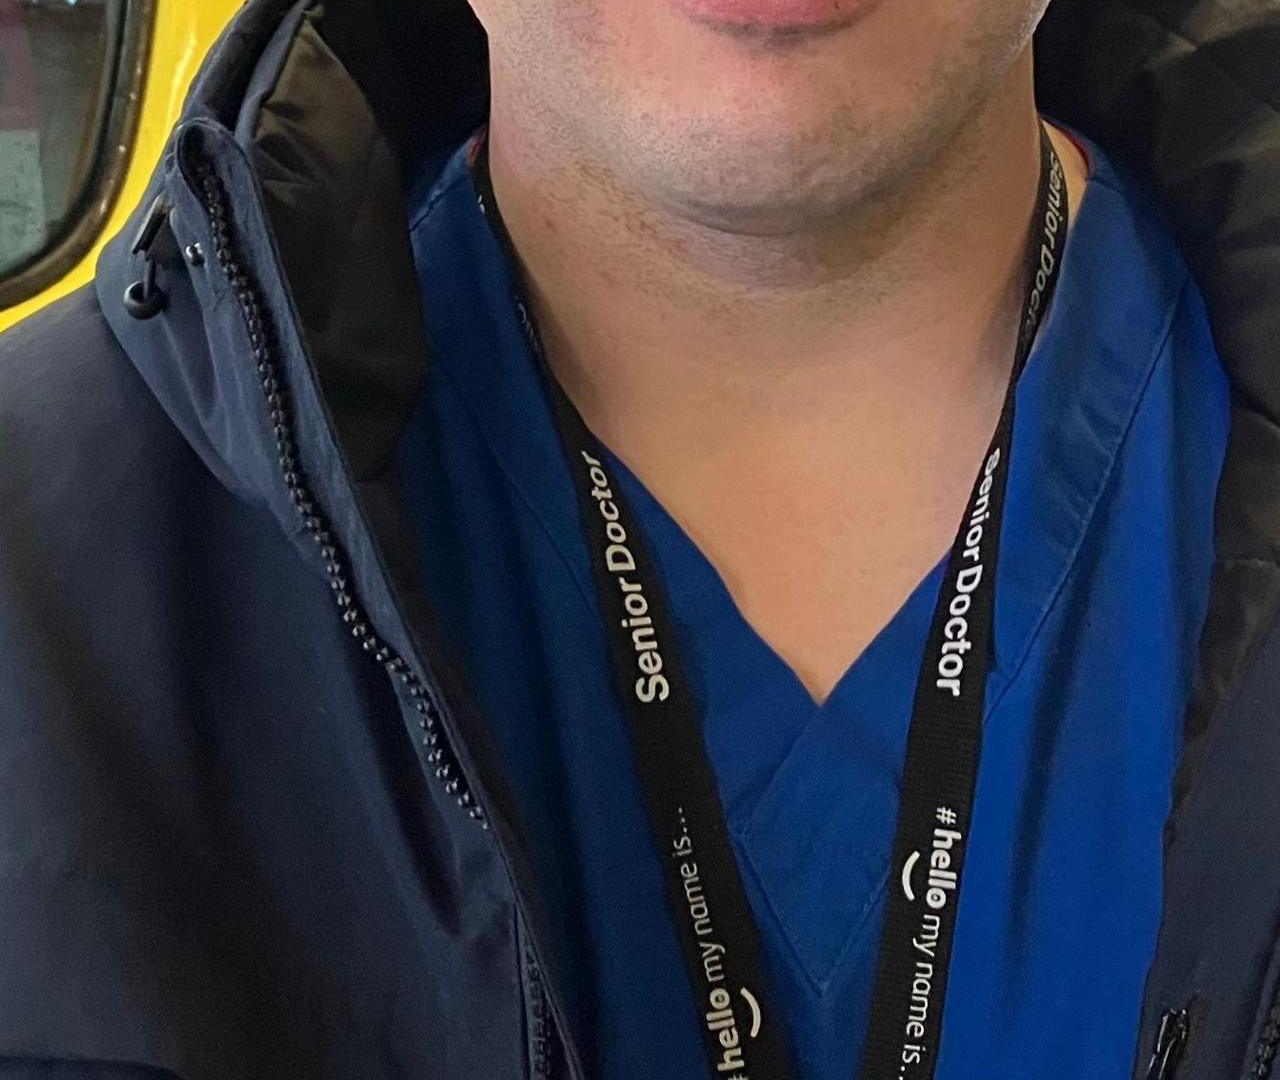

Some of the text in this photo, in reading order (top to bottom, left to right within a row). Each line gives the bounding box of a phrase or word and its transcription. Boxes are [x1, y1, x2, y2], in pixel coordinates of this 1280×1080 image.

[1043, 151, 1064, 253] Senior
[581, 449, 670, 704] Senior Doctor
[936, 447, 1001, 697] Senior Doctor
[672, 806, 694, 858] is...
[925, 805, 963, 910] #hello
[680, 862, 713, 936] name
[912, 913, 941, 958] my
[699, 940, 726, 983] my
[905, 961, 934, 1039] name
